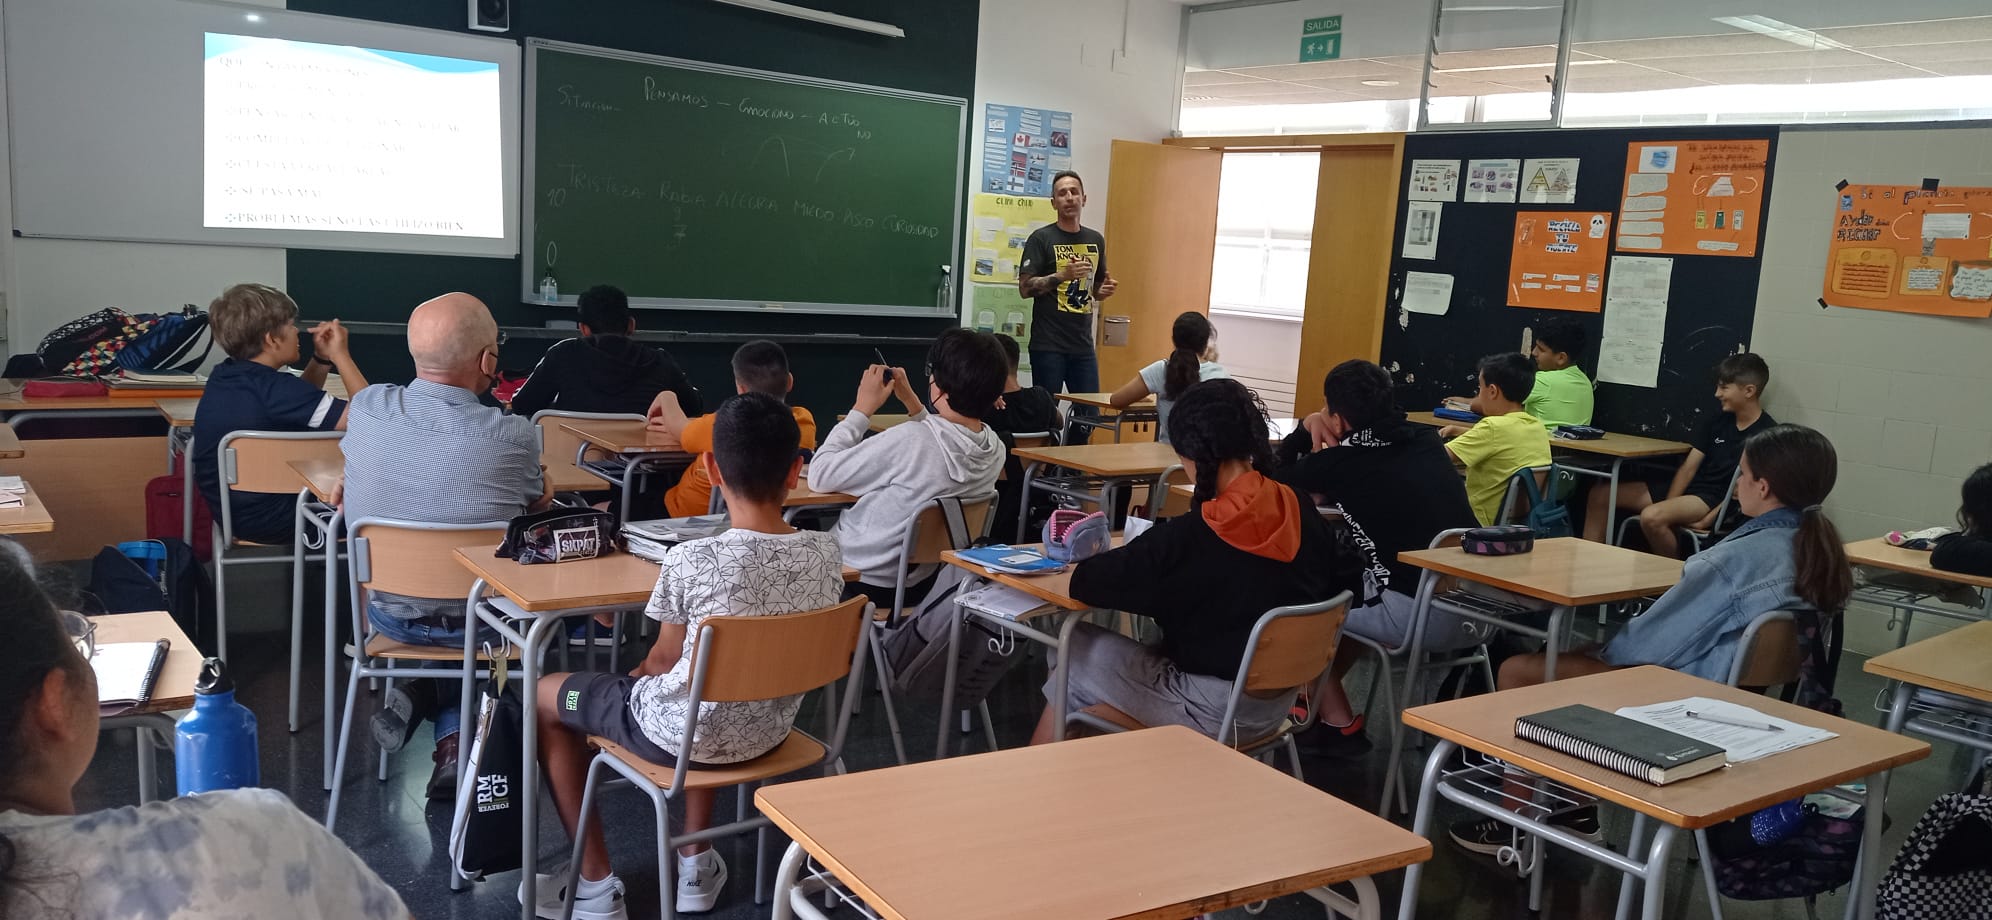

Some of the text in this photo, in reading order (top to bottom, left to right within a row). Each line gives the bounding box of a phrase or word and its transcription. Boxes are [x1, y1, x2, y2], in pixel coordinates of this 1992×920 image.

[1306, 19, 1339, 32] SALIDA
[478, 775, 493, 804] RM
[478, 803, 510, 813] FOREVER
